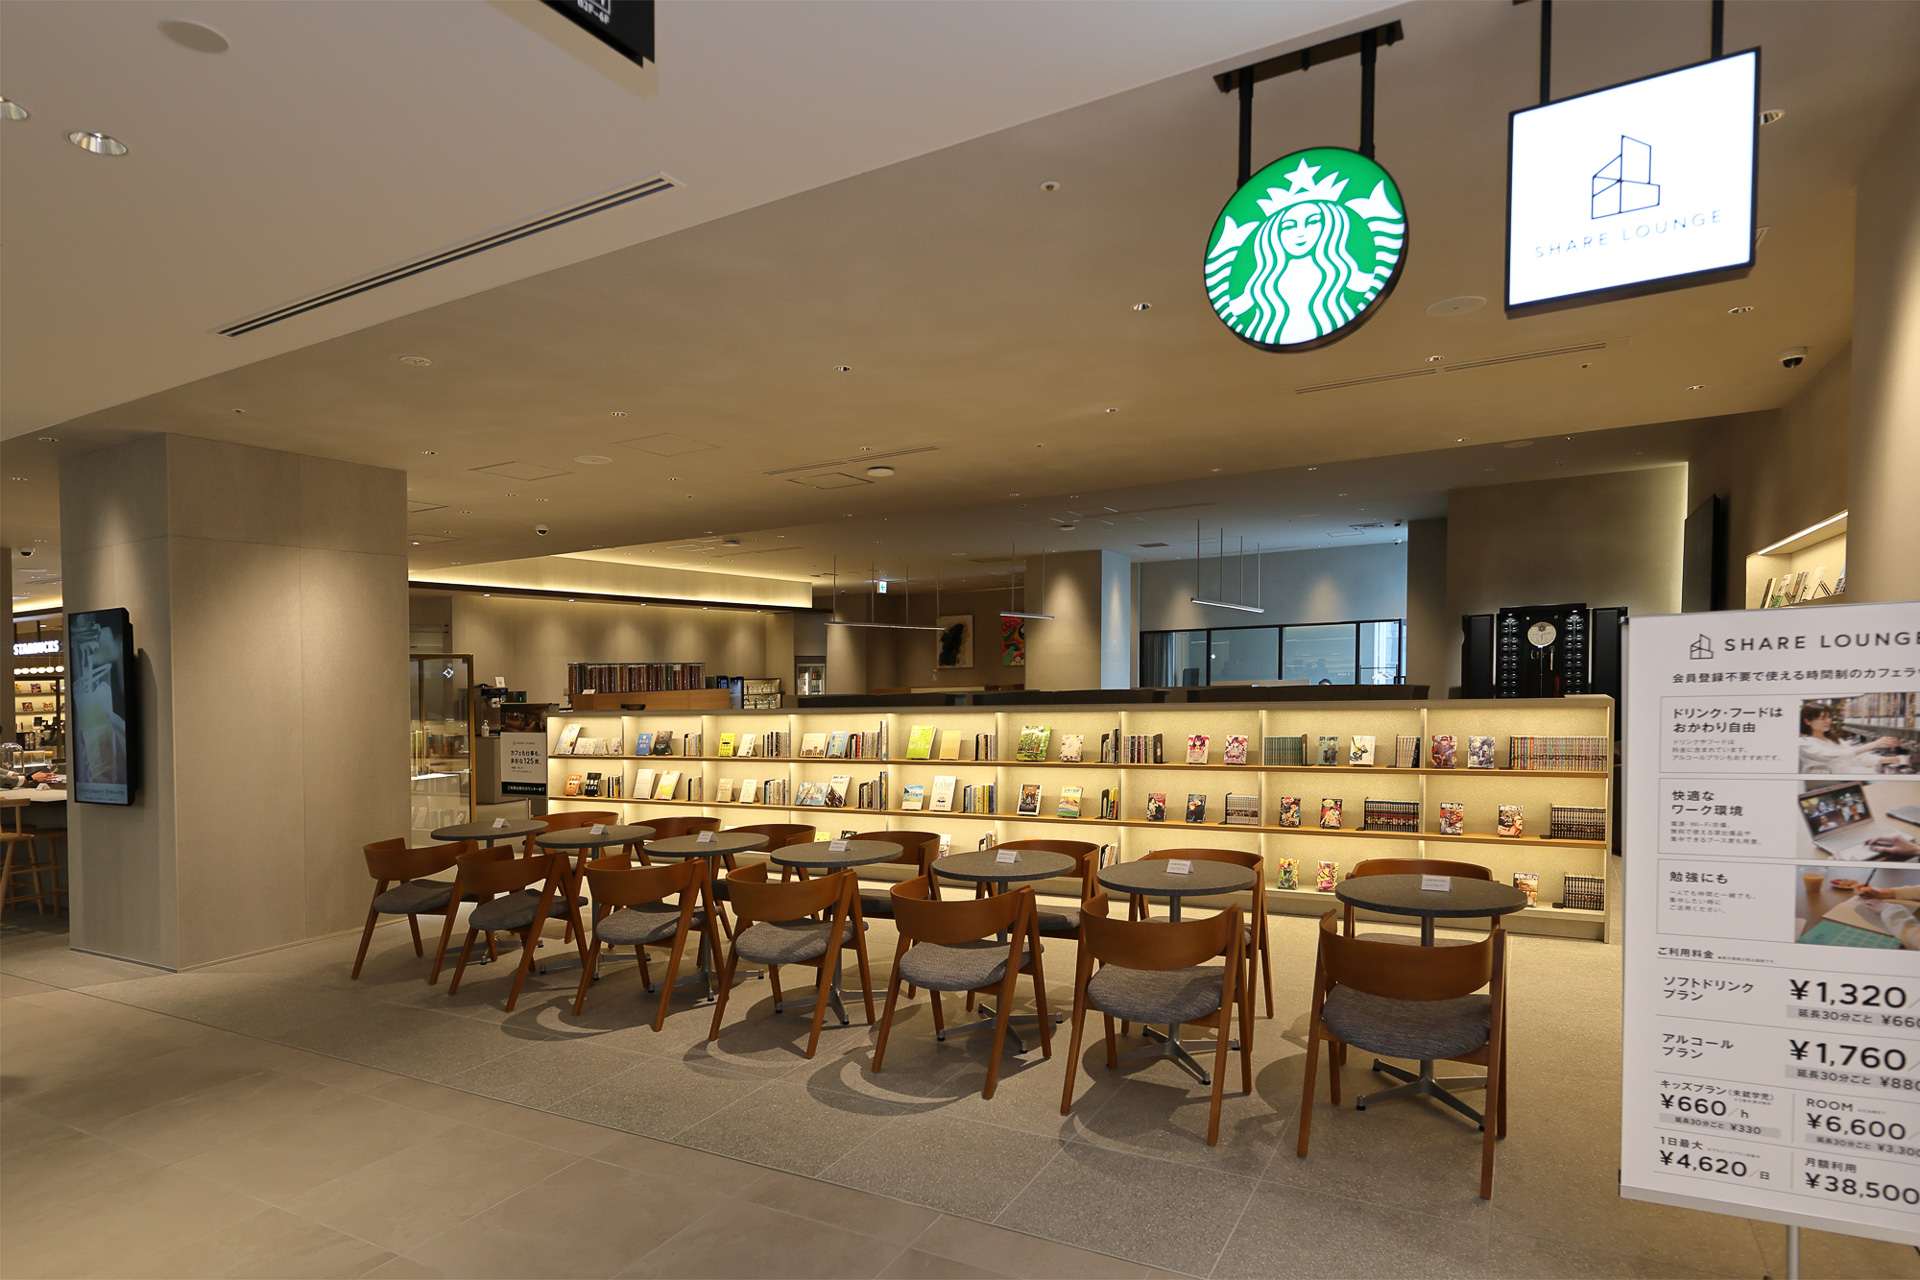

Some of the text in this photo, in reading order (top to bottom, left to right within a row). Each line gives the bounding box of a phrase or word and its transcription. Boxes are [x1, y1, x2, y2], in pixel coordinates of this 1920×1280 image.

[1535, 209, 1721, 258] SHARE LOUNGE
[1724, 631, 1920, 652] SHARE LOUNG
[1672, 667, 1920, 684] 会員登録不要で使える時間制のカフェラ
[1673, 722, 1756, 734] おかわり自由
[1671, 790, 1715, 801] 快適な
[1672, 805, 1743, 817] ワーク環境
[1669, 871, 1728, 885] 勉強にも
[1658, 947, 1714, 959] ご利用料金
[1663, 977, 1754, 994] ソフトドリンク
[1663, 989, 1704, 1001] プラン
[1788, 979, 1907, 1009] ¥1,320
[1798, 1008, 1873, 1024] 延長30分ごと
[1662, 1033, 1734, 1050] アルコール
[1662, 1046, 1704, 1059] プラン
[1788, 1039, 1907, 1071] ¥1,760
[1797, 1068, 1871, 1085] 延長30分ごと
[1806, 1098, 1853, 1112] ROOM
[1730, 1123, 1762, 1135] ¥330
[1806, 1113, 1906, 1140] ¥6,600
[1660, 1136, 1703, 1150] 1日最大
[1805, 1157, 1857, 1174] 月額利用
[1805, 1172, 1920, 1205] ¥38,500
